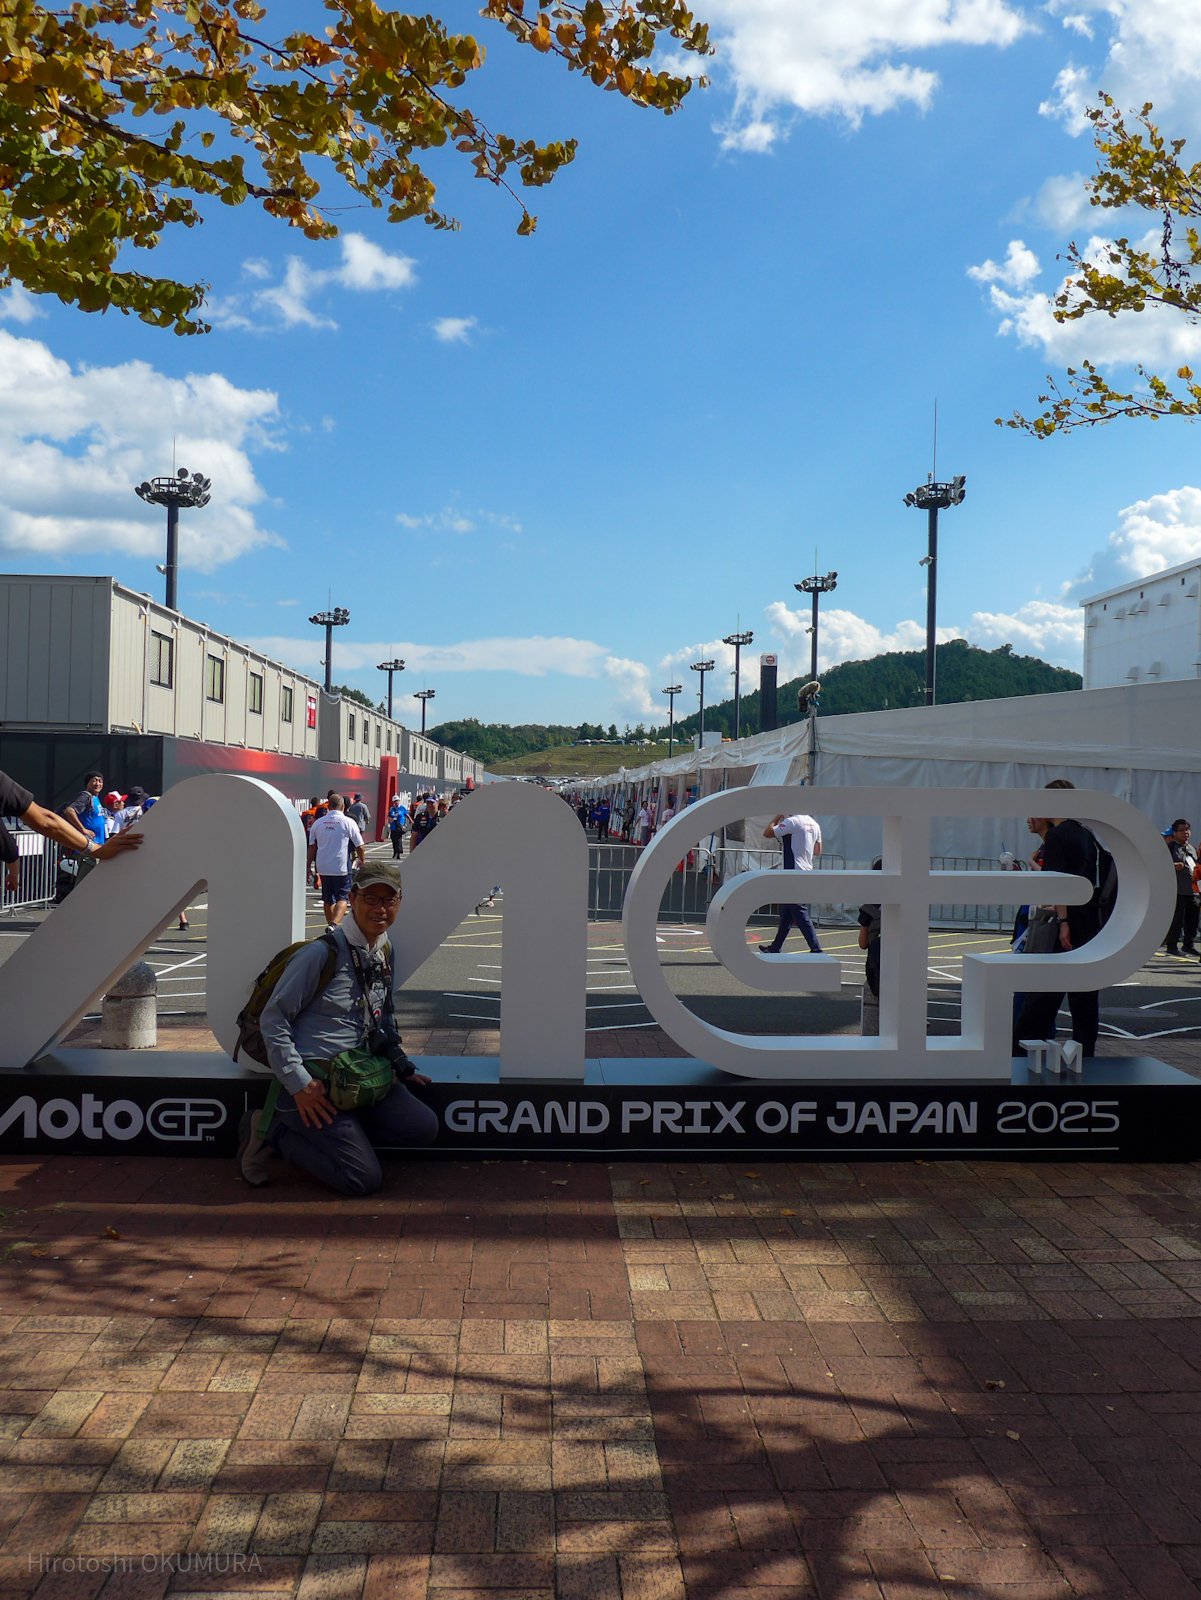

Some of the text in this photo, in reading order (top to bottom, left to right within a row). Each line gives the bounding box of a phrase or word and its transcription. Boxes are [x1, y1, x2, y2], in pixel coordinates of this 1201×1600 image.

[444, 1100, 1120, 1133] GRAND PRIX OF JAPAN 2025
